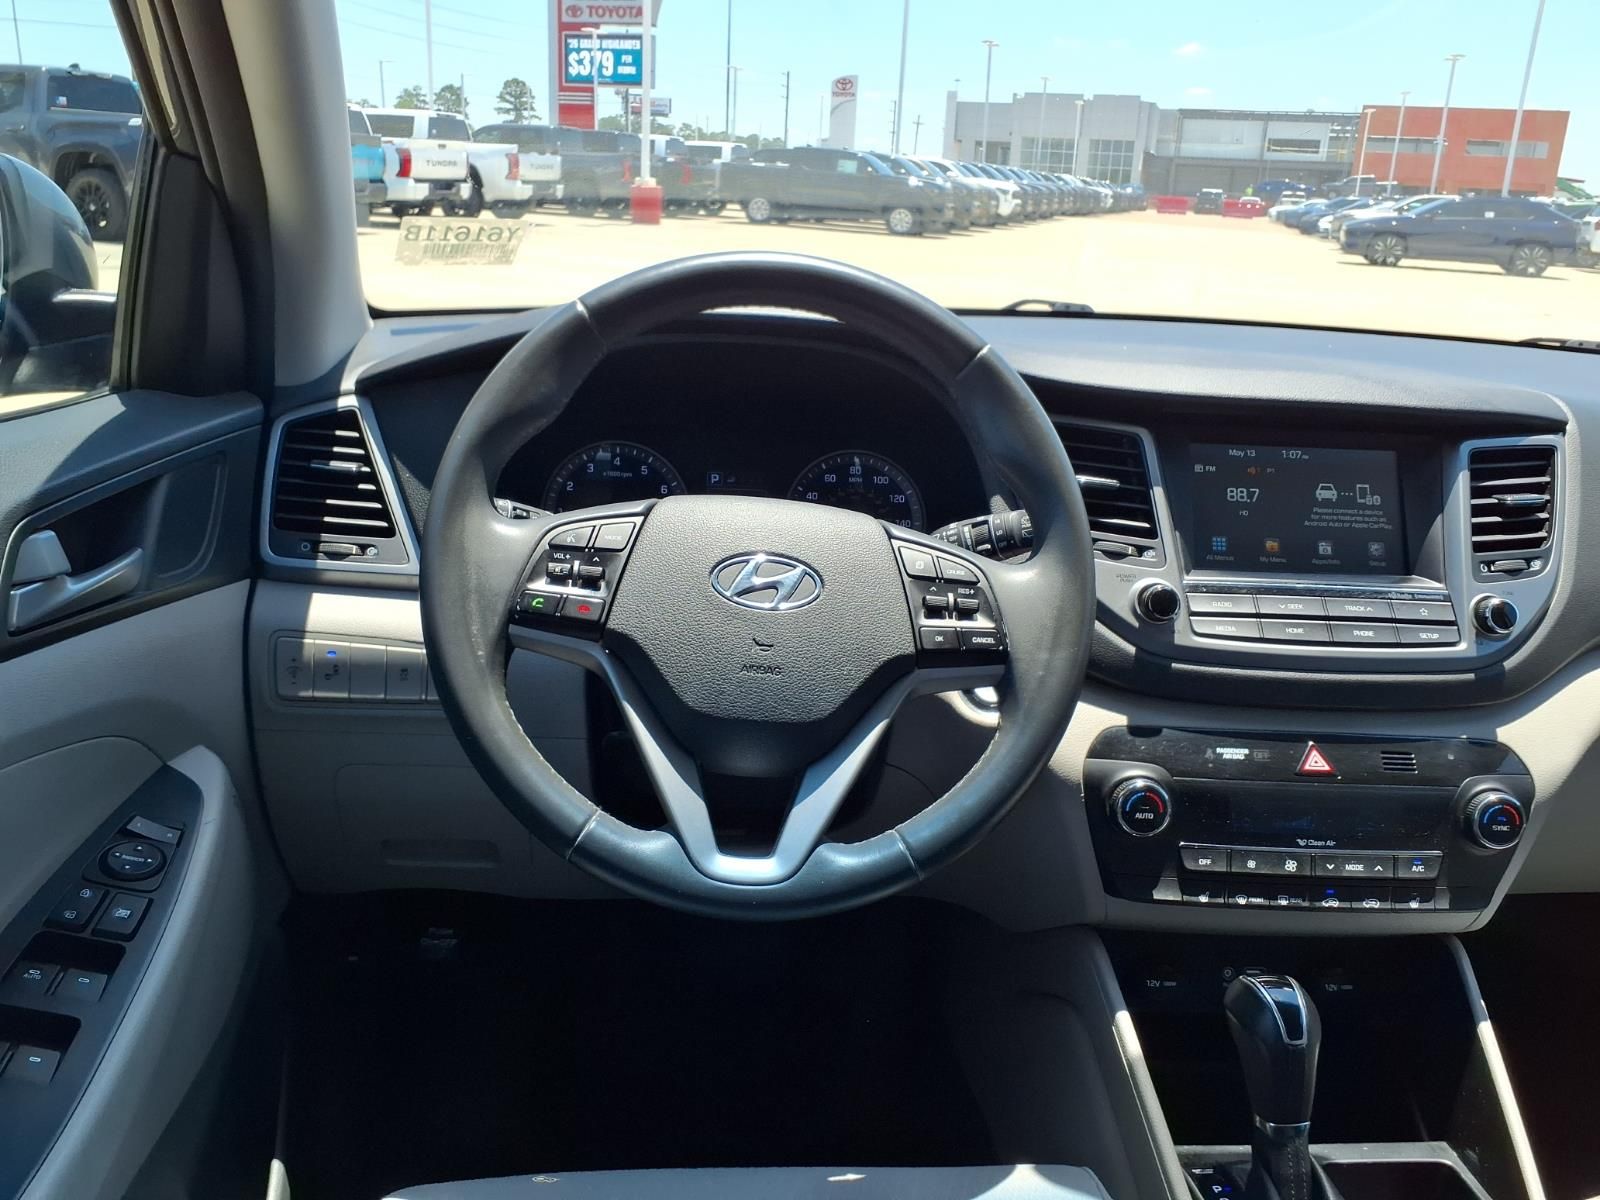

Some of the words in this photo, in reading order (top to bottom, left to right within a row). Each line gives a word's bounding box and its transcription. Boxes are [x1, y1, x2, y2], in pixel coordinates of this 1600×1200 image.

[586, 6, 643, 18] TOYOTA
[568, 50, 615, 77] $379
[1228, 449, 1245, 458] May
[1246, 449, 1256, 457] 13
[1281, 450, 1302, 459] 1:07
[613, 457, 620, 466] 4
[586, 464, 594, 473] 3
[641, 465, 648, 475] 5
[849, 466, 862, 475] 80
[711, 474, 719, 484] P
[824, 474, 836, 483] 60
[873, 476, 889, 484] 100
[566, 482, 574, 491] 2
[660, 485, 668, 494] 6
[806, 492, 818, 500] 40
[889, 494, 905, 503] 120
[1227, 488, 1259, 502] 88.7
[1287, 602, 1304, 610] SEEK
[971, 636, 996, 644] CANCEL
[1419, 632, 1440, 640] SETUP
[1135, 812, 1154, 820] AUTO
[1491, 824, 1511, 832] SYNC
[1307, 839, 1325, 847] Clean
[1326, 839, 1337, 847] Air
[1198, 858, 1212, 866] OFF
[1146, 979, 1160, 987] 12V
[1211, 1184, 1223, 1194] P
